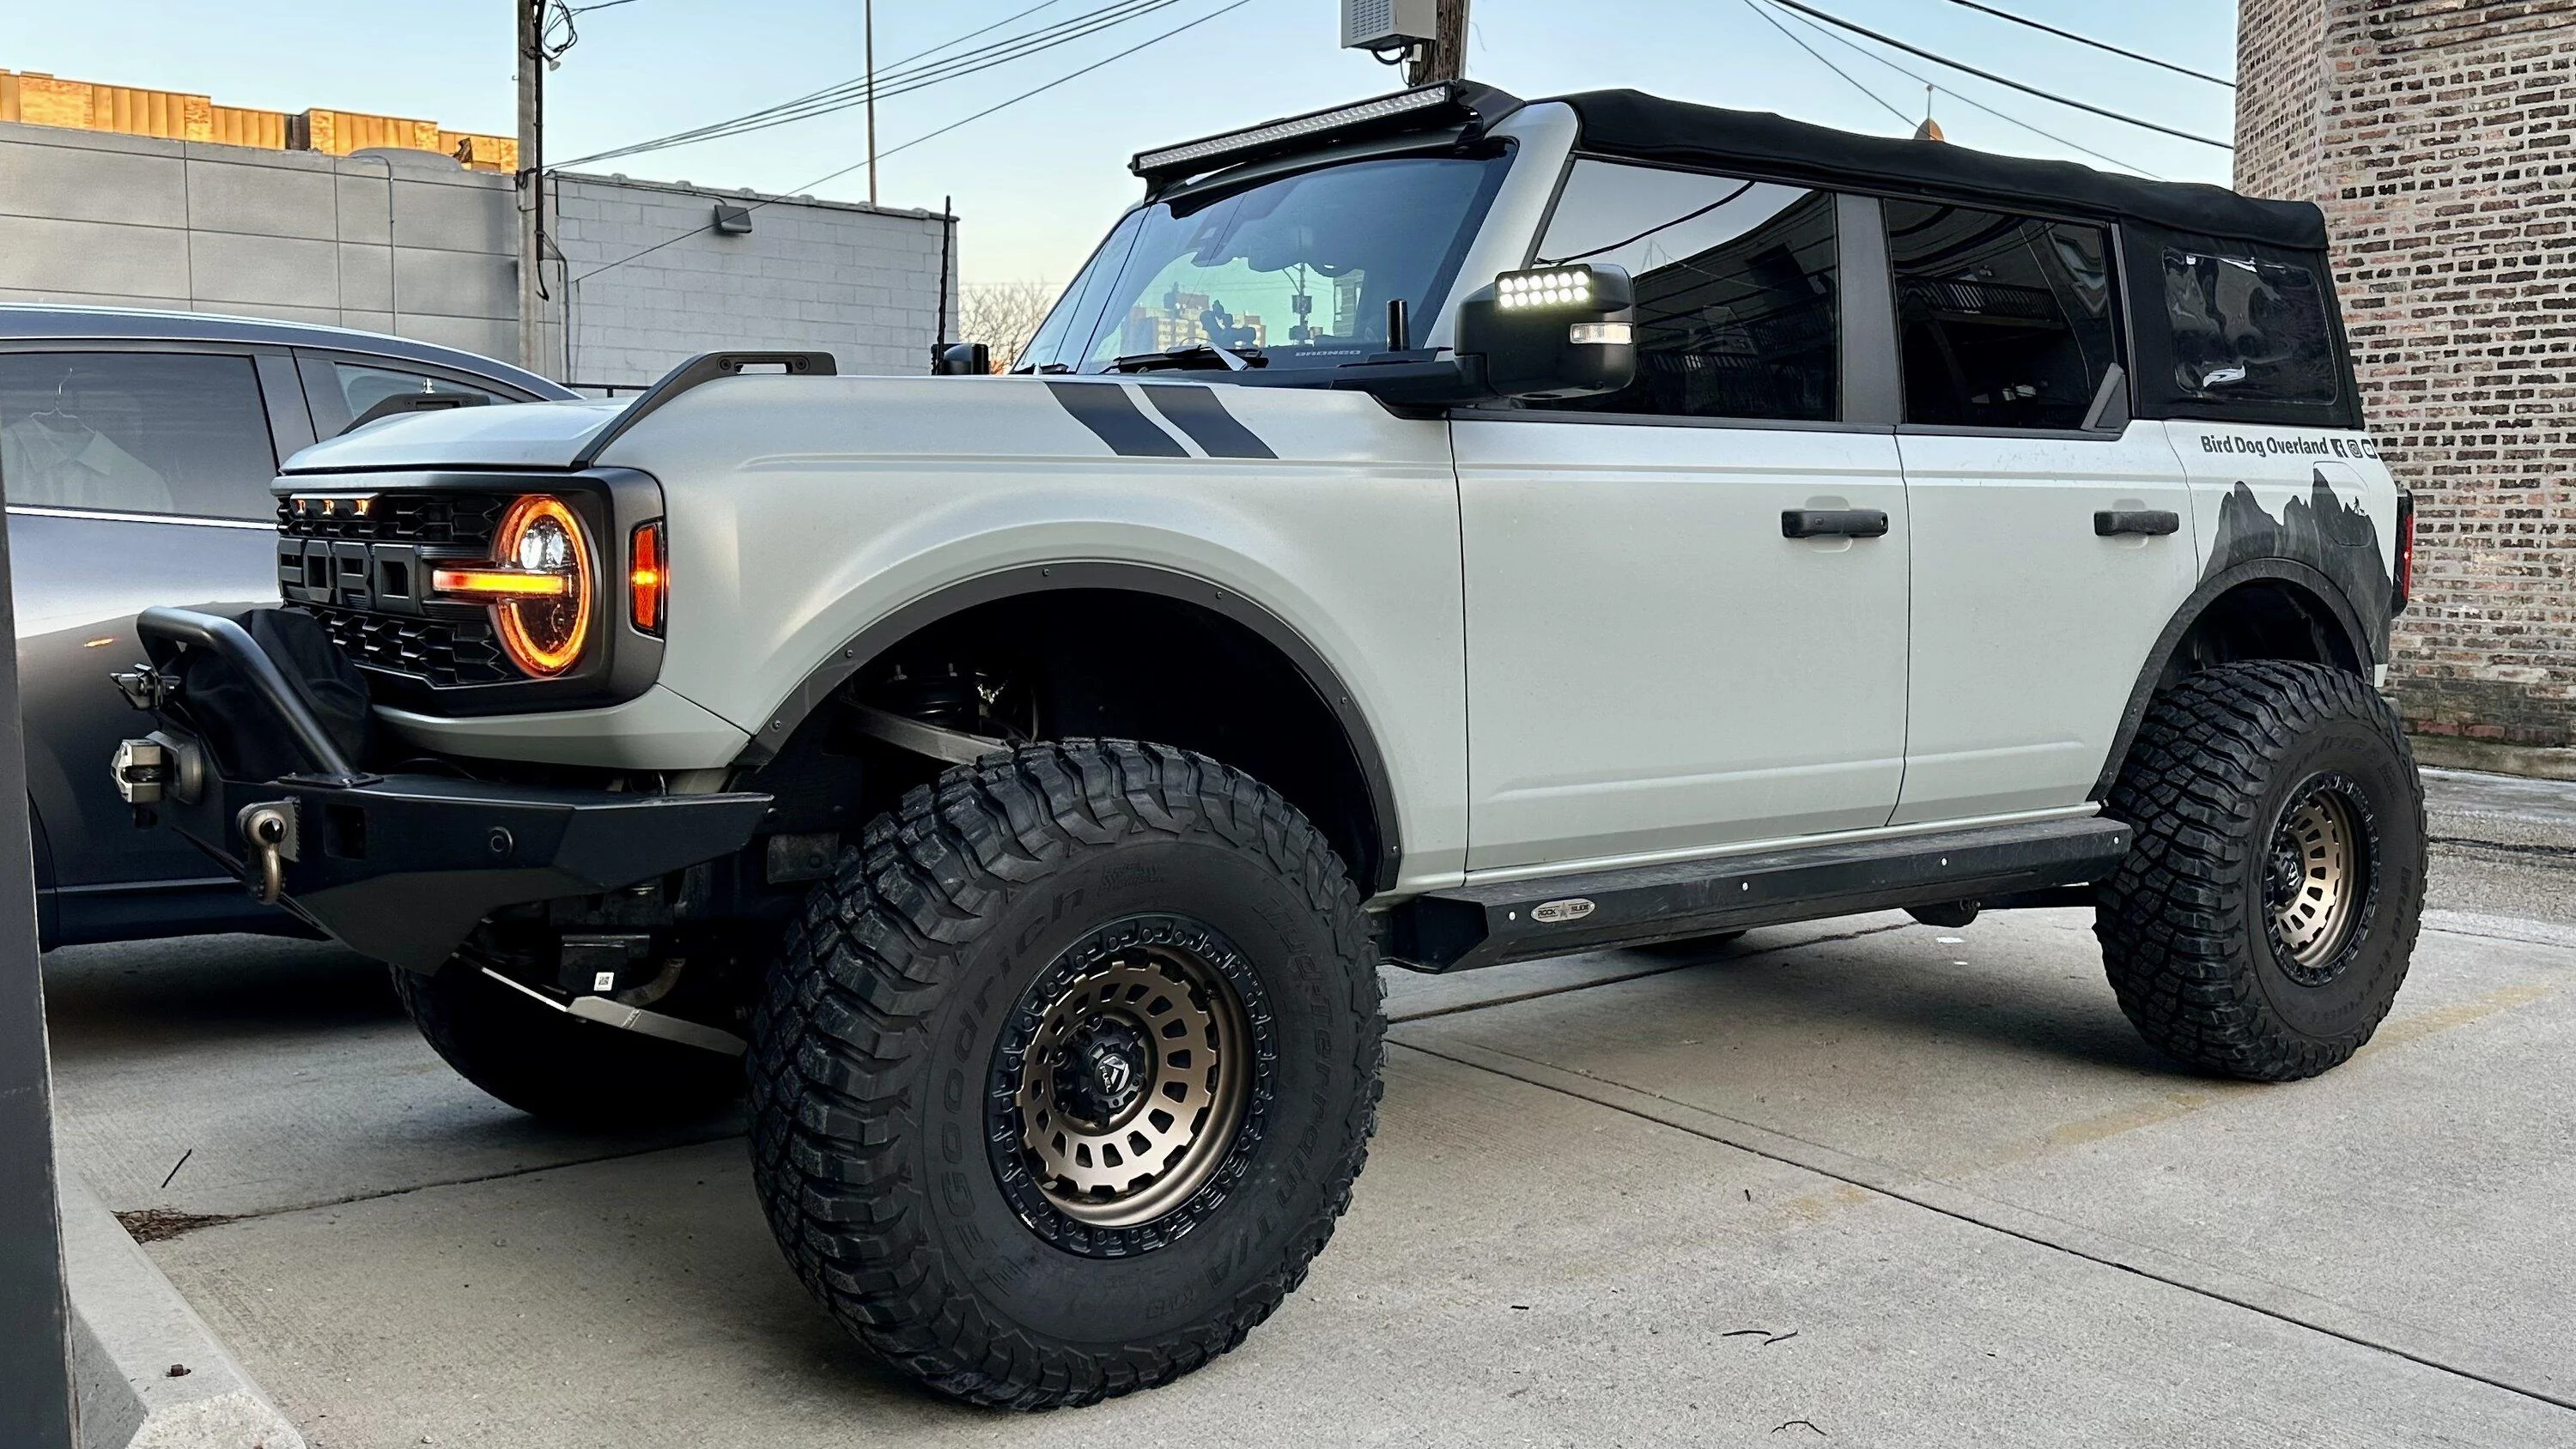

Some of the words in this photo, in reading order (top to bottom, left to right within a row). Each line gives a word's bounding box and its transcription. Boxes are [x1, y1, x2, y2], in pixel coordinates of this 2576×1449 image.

[2200, 435, 2233, 453] Bird
[2234, 436, 2266, 458] Dog
[2266, 436, 2330, 454] Overland
[277, 537, 421, 616] FORD
[1100, 1066, 1111, 1094] FUEL
